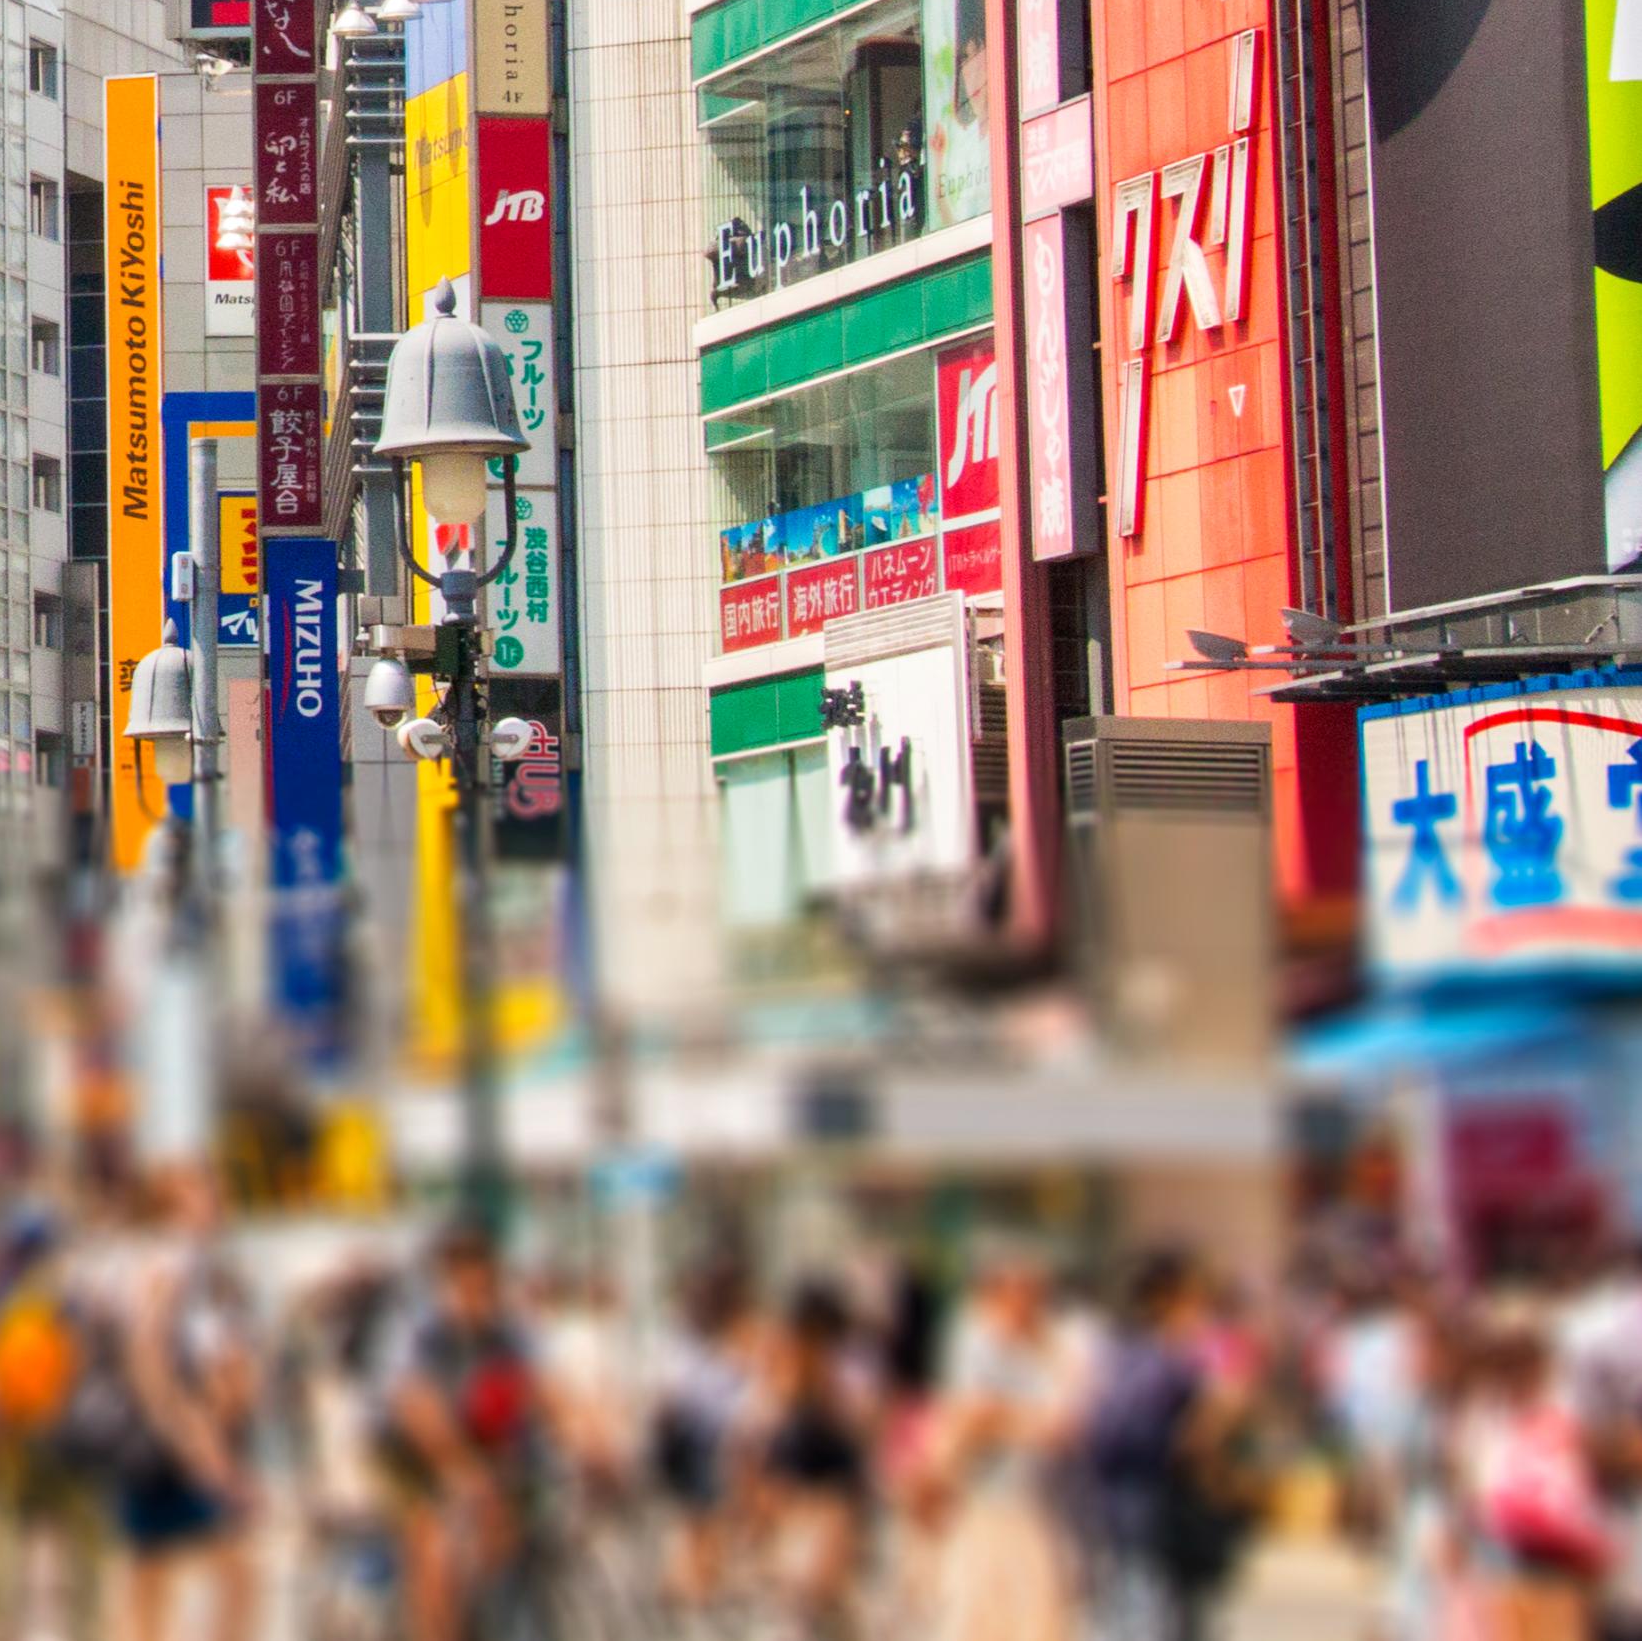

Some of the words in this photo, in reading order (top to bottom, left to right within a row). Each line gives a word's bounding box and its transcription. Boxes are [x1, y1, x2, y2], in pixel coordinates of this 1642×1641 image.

[273, 90, 297, 106] 6F
[502, 89, 524, 105] 4F
[485, 189, 546, 225] JTB
[716, 156, 916, 294] Euphoria
[119, 180, 147, 309] KiYoshi
[275, 240, 302, 257] 6F
[277, 386, 304, 402] 6F
[520, 339, 545, 431] フルーツ
[123, 315, 150, 521] Matsumoto
[269, 409, 305, 514] 餃子屋台
[524, 526, 549, 624] 渋谷西村
[869, 543, 934, 582] ハネムーン
[723, 587, 781, 641] 国内旅行
[793, 570, 856, 624] 海外旅行
[295, 578, 324, 719] MIZUHO
